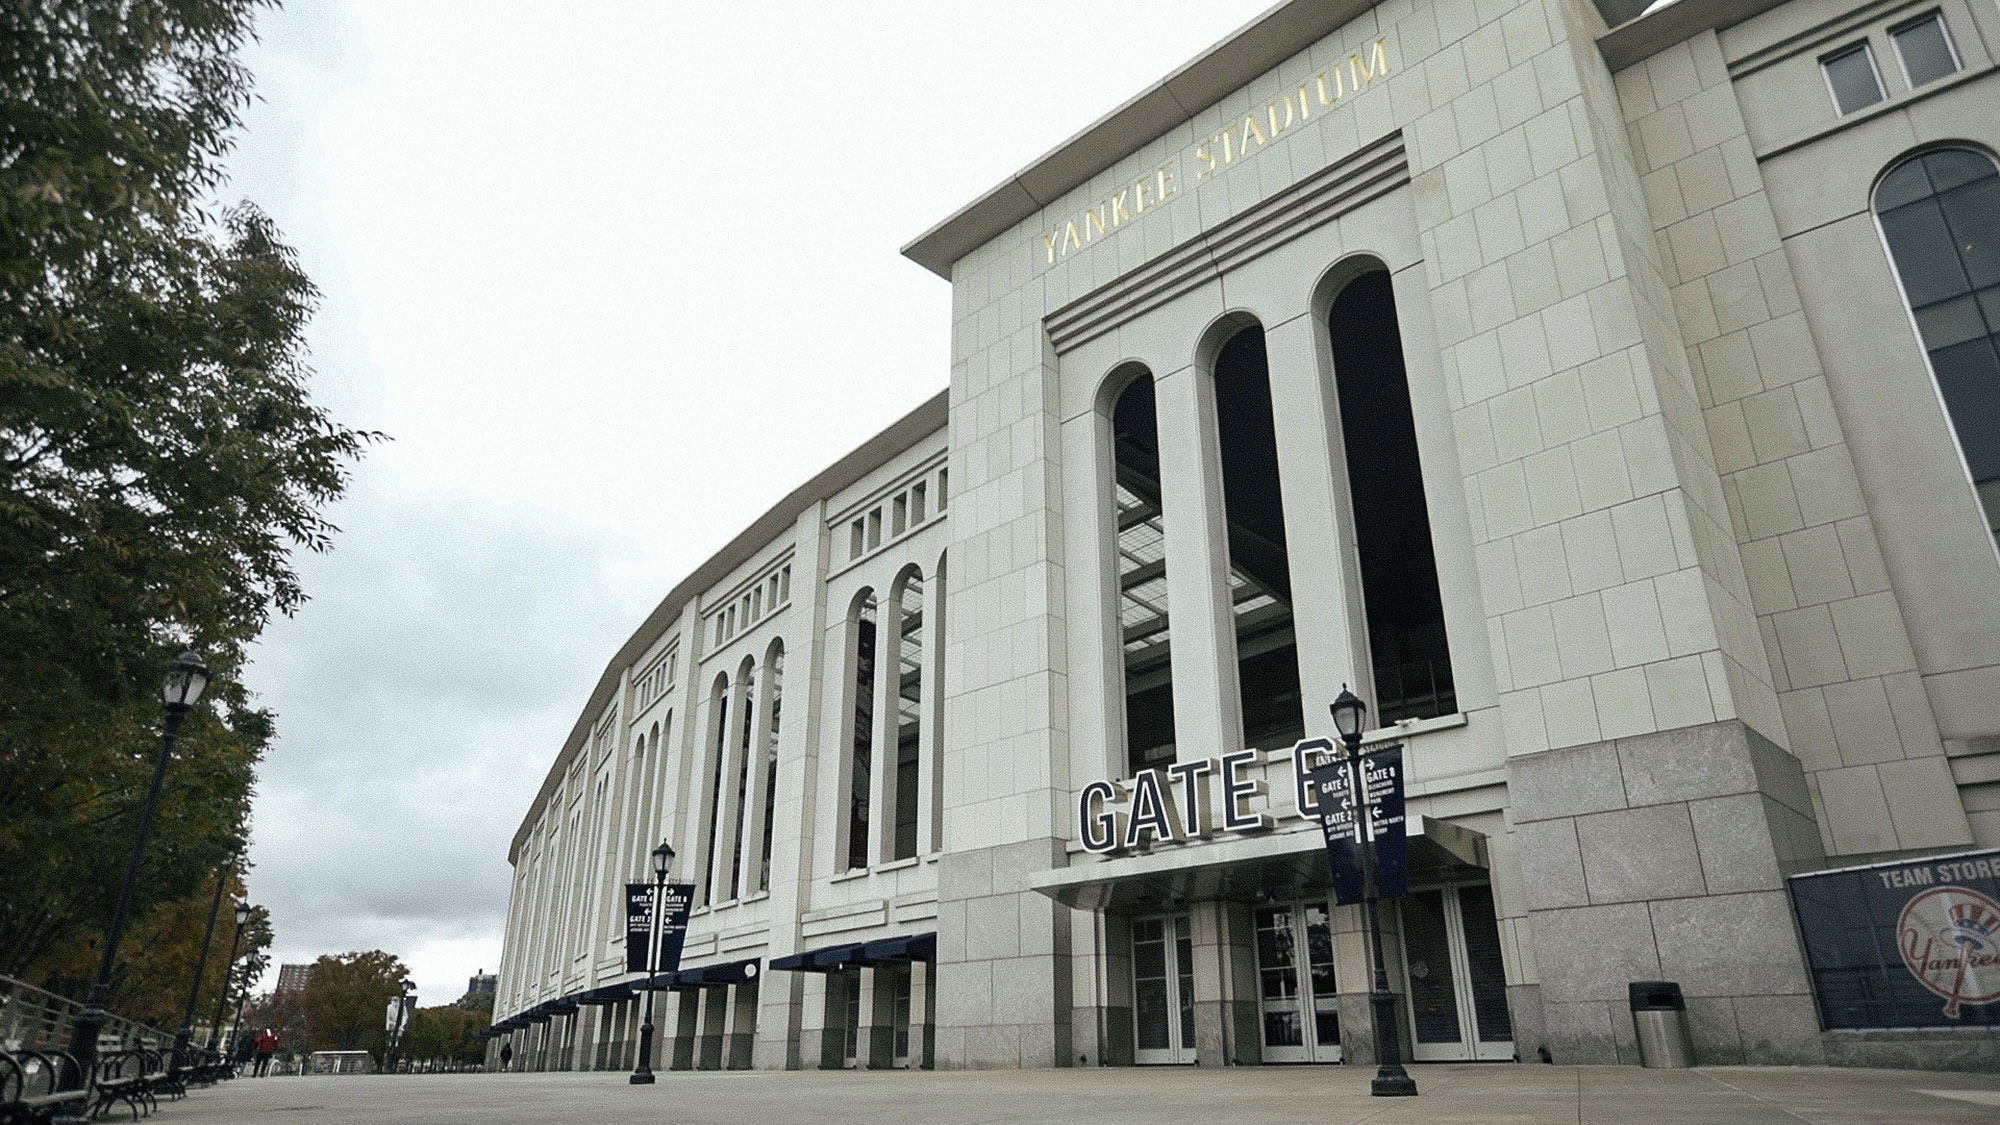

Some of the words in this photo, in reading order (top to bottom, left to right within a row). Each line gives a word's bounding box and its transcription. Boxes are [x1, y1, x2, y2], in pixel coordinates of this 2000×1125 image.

[1042, 162, 1178, 264] YANKEE
[1196, 37, 1391, 180] STADIUM
[1367, 769, 1389, 782] GATE
[1389, 767, 1396, 777] 8
[1322, 780, 1342, 793] GATE
[1343, 778, 1349, 788] 4
[1080, 748, 1263, 854] GATE
[1326, 812, 1346, 825] GATE
[1347, 810, 1352, 821] 2
[1880, 867, 1933, 889] TEAM
